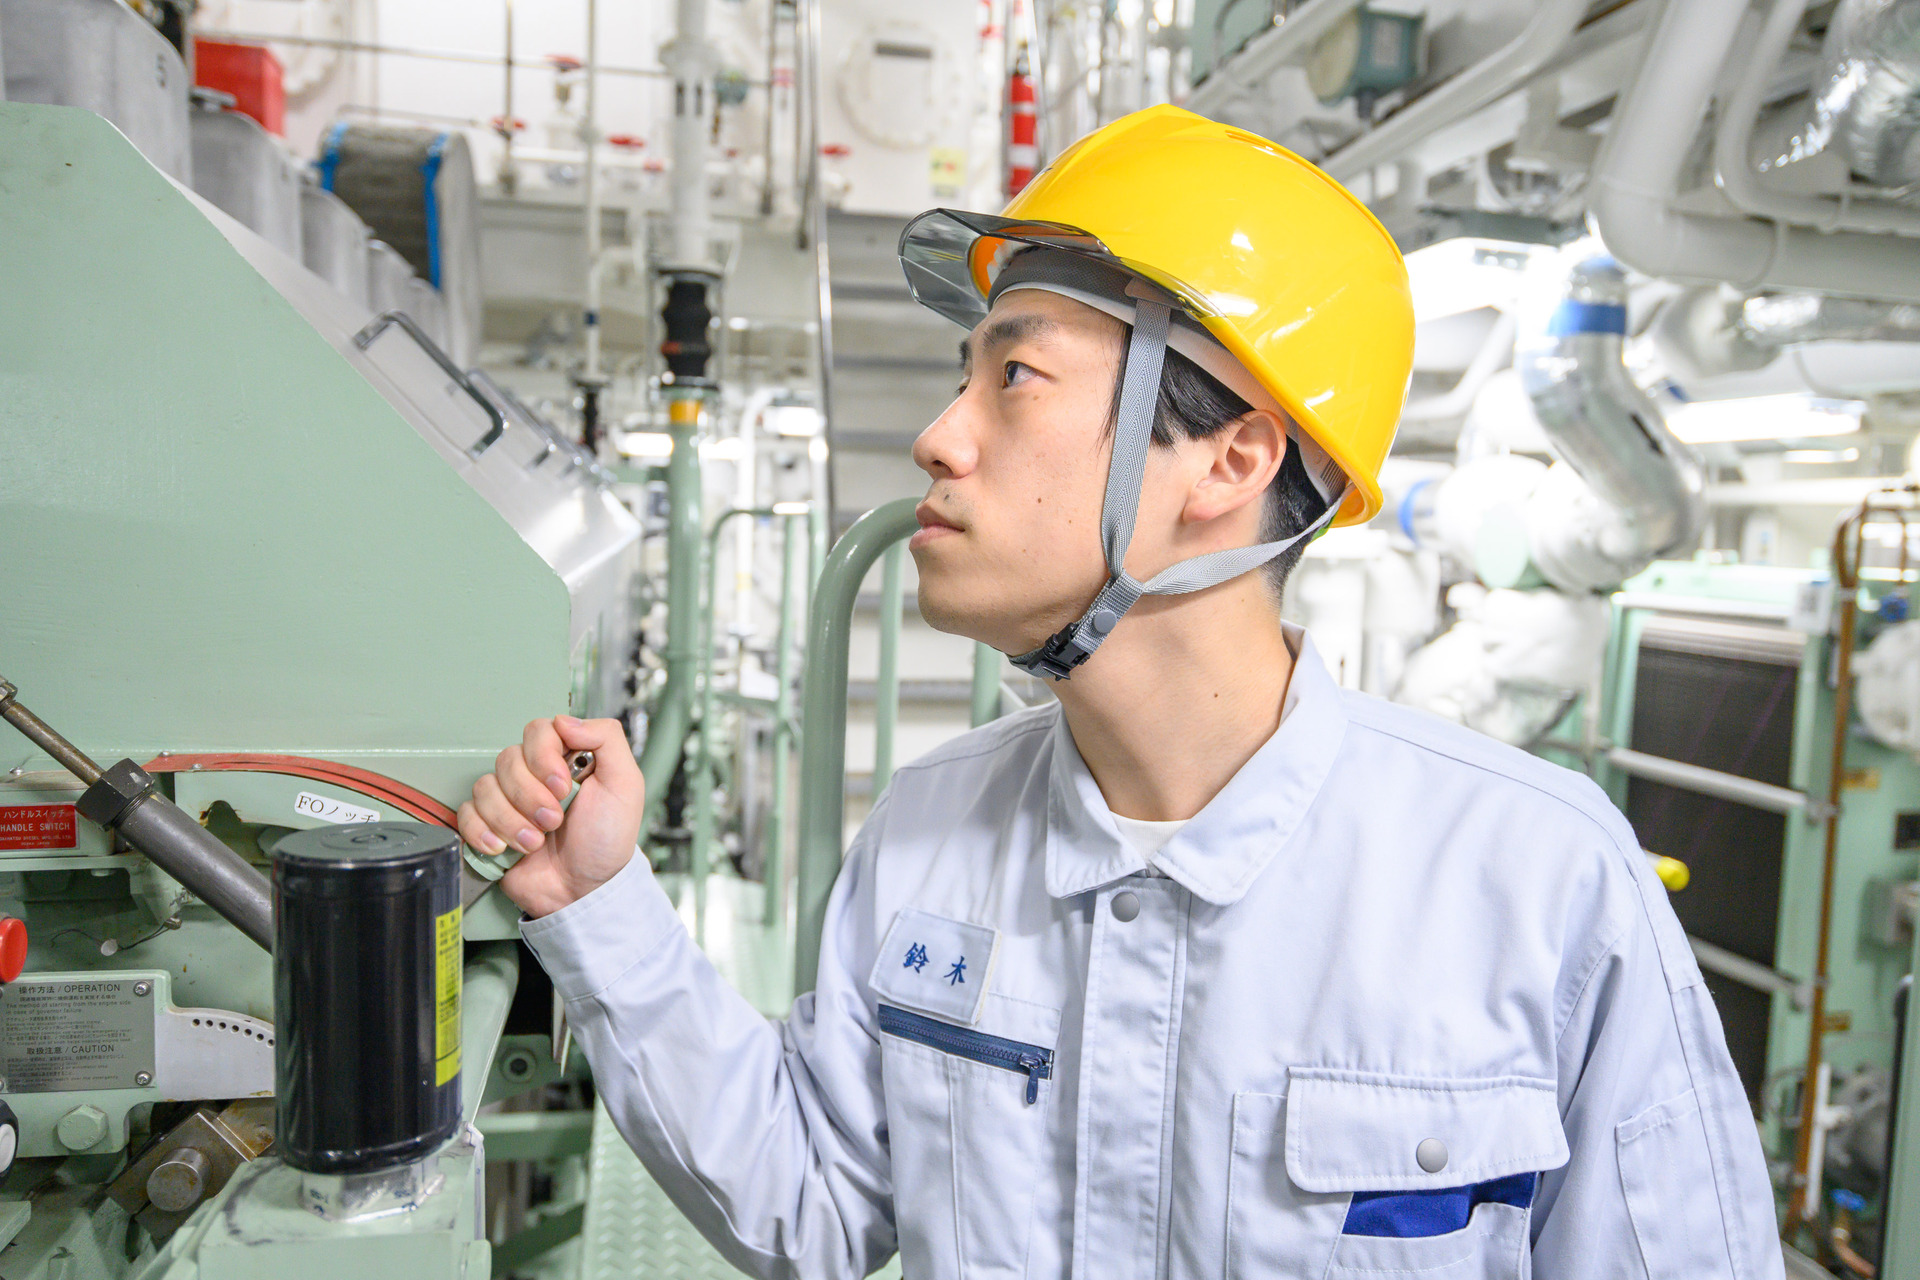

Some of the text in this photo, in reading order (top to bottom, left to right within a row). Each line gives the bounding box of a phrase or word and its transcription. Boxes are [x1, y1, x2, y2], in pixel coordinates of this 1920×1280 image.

[3, 809, 65, 819] ハンドルスイッチ
[0, 822, 70, 832] HANDLE SWITCH
[903, 942, 967, 986] 鈴木
[19, 986, 55, 995] 操作方法
[64, 984, 120, 993] OPERATION
[27, 1047, 62, 1055] 取扱注意
[71, 1045, 114, 1054] CAUTION
